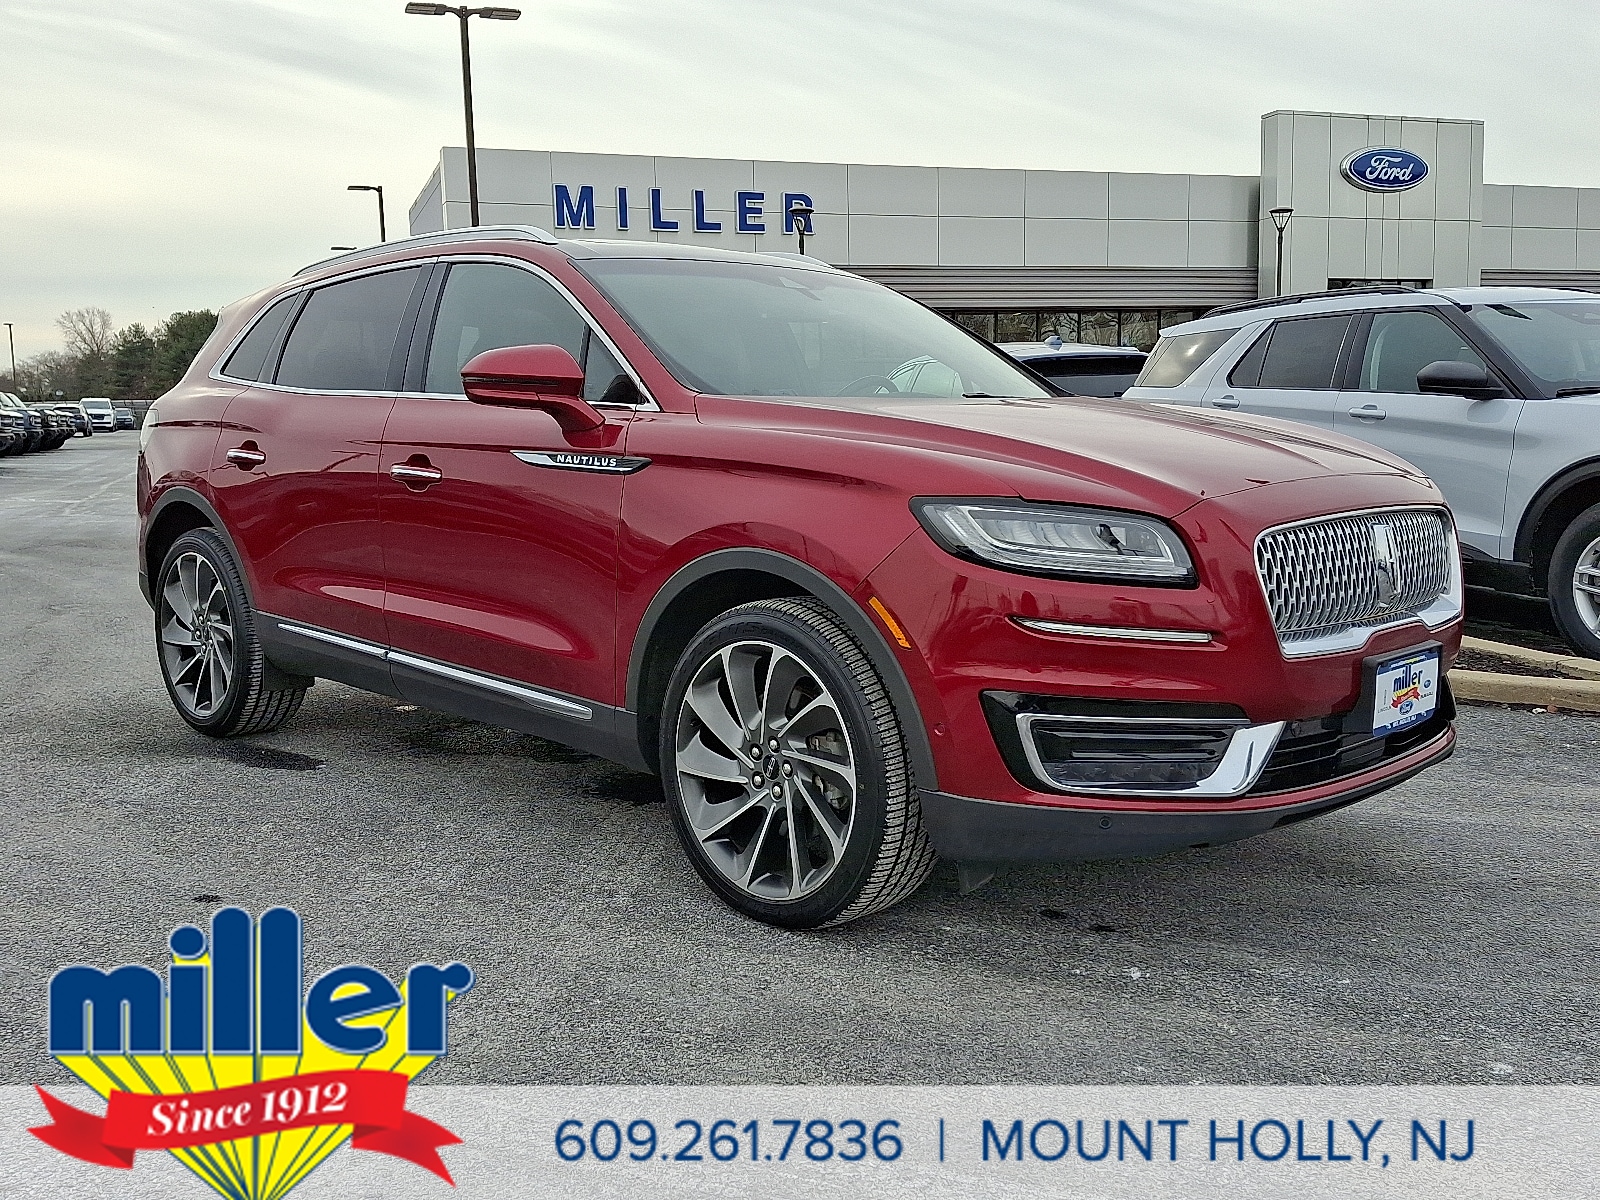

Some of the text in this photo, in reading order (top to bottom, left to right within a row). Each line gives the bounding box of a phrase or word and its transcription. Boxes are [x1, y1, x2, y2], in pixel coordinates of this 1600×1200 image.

[1365, 155, 1415, 181] Ford
[553, 183, 815, 235] MILLER
[556, 454, 617, 467] NAUTILUS
[1392, 664, 1423, 692] miller
